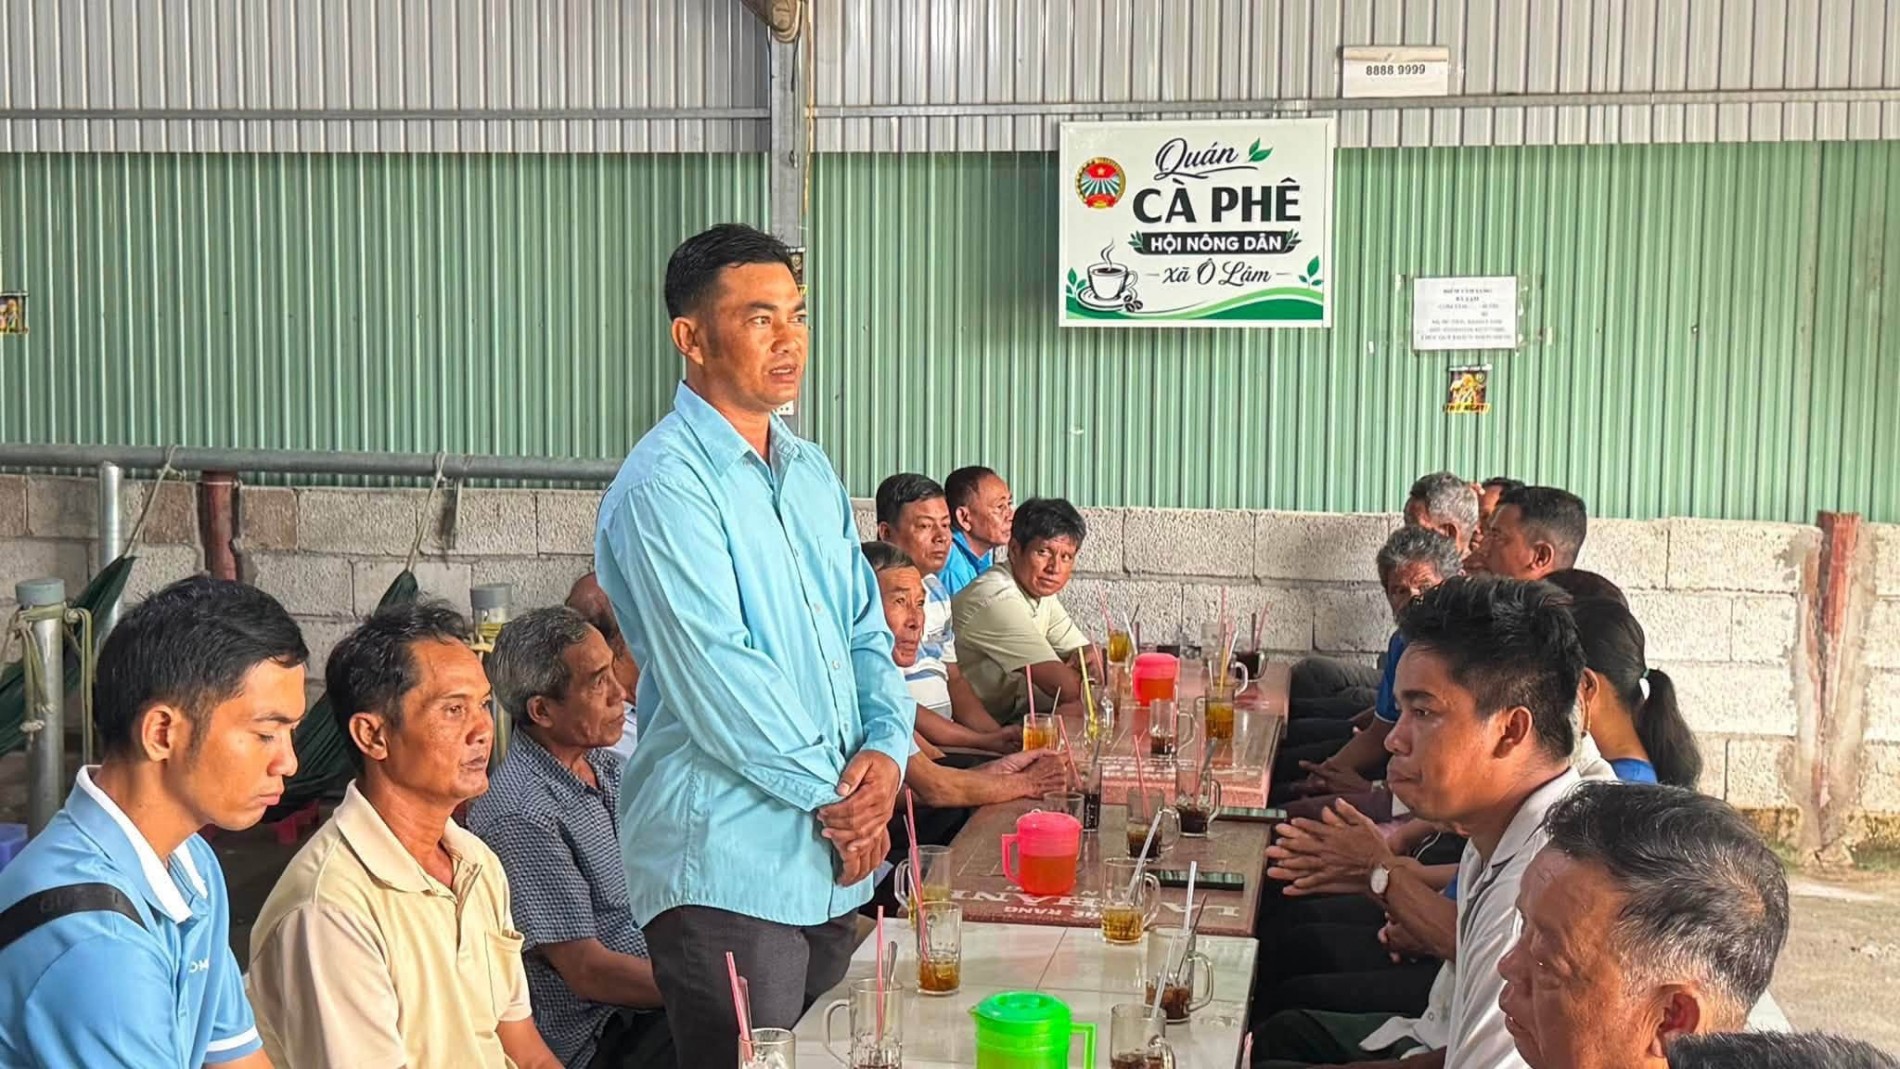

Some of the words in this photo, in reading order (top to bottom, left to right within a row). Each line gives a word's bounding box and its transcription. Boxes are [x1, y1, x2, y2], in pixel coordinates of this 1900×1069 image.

[1365, 64, 1394, 76] 8888
[1397, 63, 1426, 75] 9999
[1154, 137, 1239, 181] Quán
[1132, 177, 1197, 224] CÀ
[1211, 176, 1301, 223] PHÊ
[1150, 234, 1182, 254] HỘI
[1186, 233, 1240, 251] NÔNG
[1244, 232, 1282, 251] DÂN
[1162, 266, 1192, 284] xã
[1197, 257, 1216, 285] Ô
[1218, 261, 1272, 287] Lâm
[1000, 904, 1063, 917] RANG
